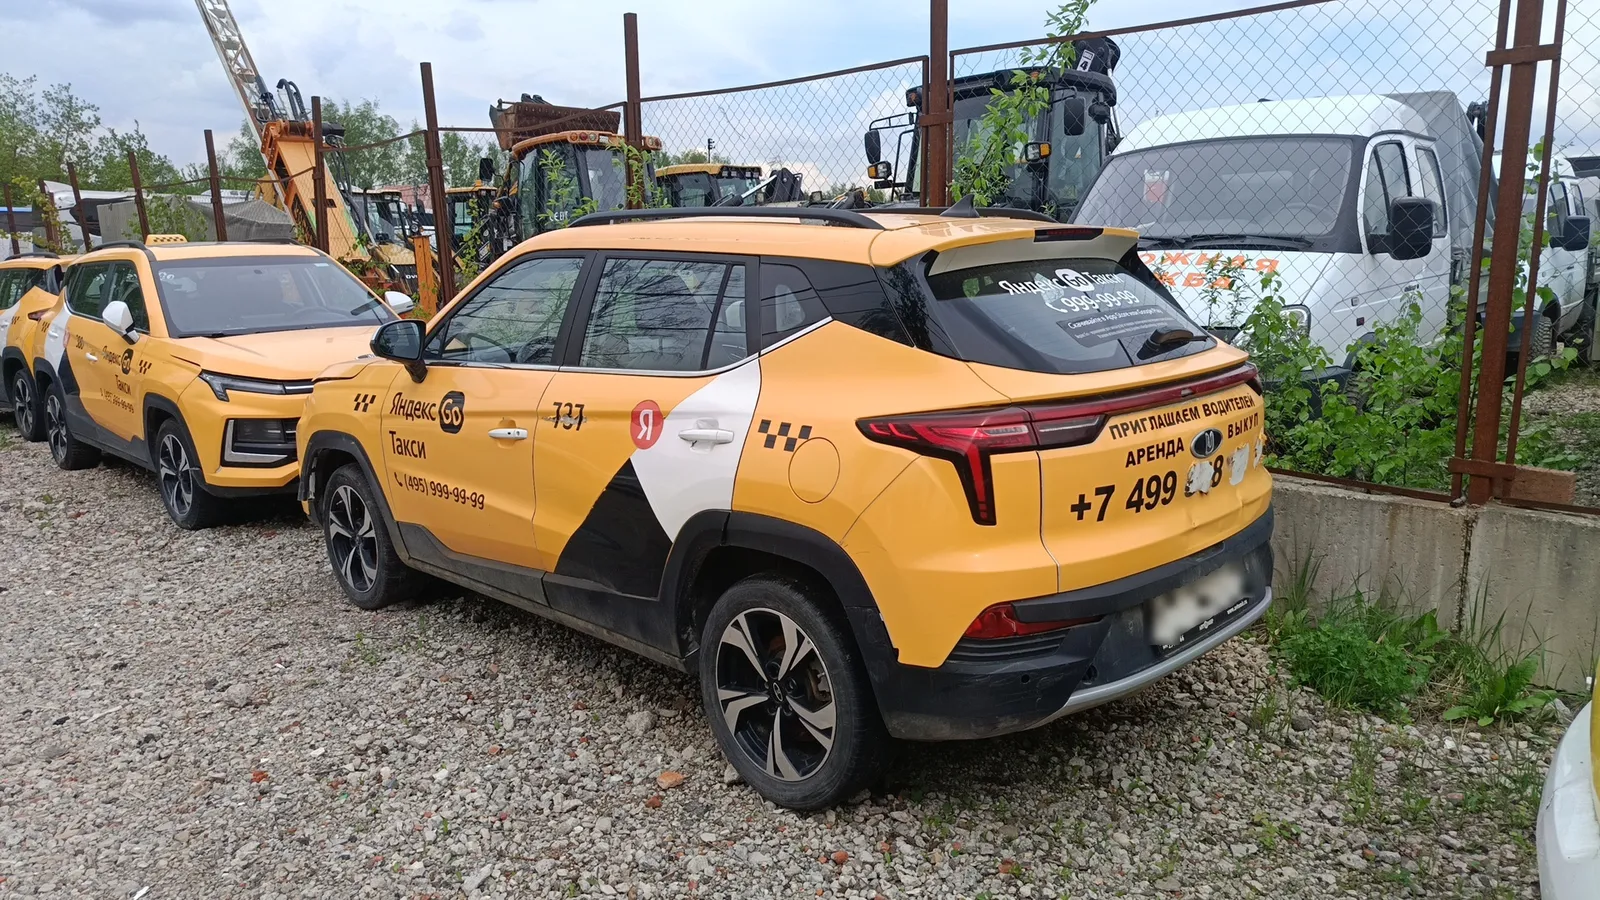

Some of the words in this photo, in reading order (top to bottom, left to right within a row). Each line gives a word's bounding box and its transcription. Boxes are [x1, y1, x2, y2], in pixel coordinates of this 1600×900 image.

[998, 277, 1067, 296] Яндекс
[1081, 272, 1125, 285] Такси
[1061, 290, 1140, 312] 999-99-99
[1116, 311, 1129, 319] Store
[114, 374, 132, 396] Такси
[389, 391, 437, 422] Яндекс
[440, 397, 463, 427] Go
[552, 401, 586, 431] 737
[637, 408, 654, 441] Я
[1109, 407, 1201, 440] ПРИГЛАШАЕМ
[1202, 394, 1256, 417] ВОДИТЕЛЕЙ
[389, 430, 427, 460] Такси
[1125, 437, 1185, 468] АРЕНДА
[1227, 412, 1259, 439] ВЫКУП
[403, 472, 429, 496] (495)
[429, 479, 486, 510] 999-99-99
[1070, 484, 1116, 522] +7
[1125, 470, 1178, 514] 499
